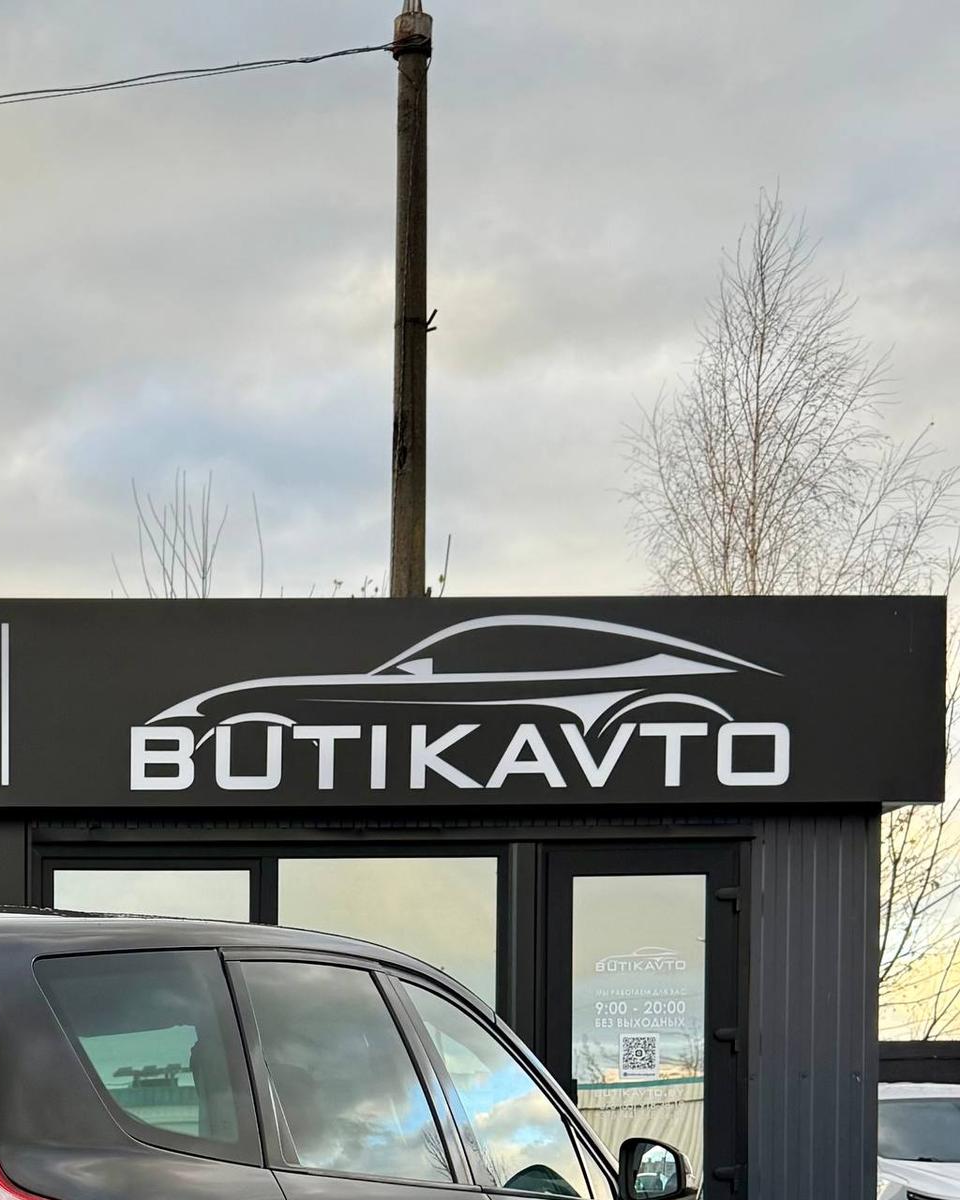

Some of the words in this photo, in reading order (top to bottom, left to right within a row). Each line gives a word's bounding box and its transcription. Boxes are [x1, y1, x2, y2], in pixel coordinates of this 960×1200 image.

[131, 722, 790, 790] BUTIKAVTO
[595, 960, 687, 972] BUTIKAVTO
[595, 1001, 628, 1015] 9:00
[643, 1001, 686, 1015] 20:00
[595, 1018, 613, 1028] БЕЗ
[617, 1017, 685, 1028] ВЫХОДНЫХ
